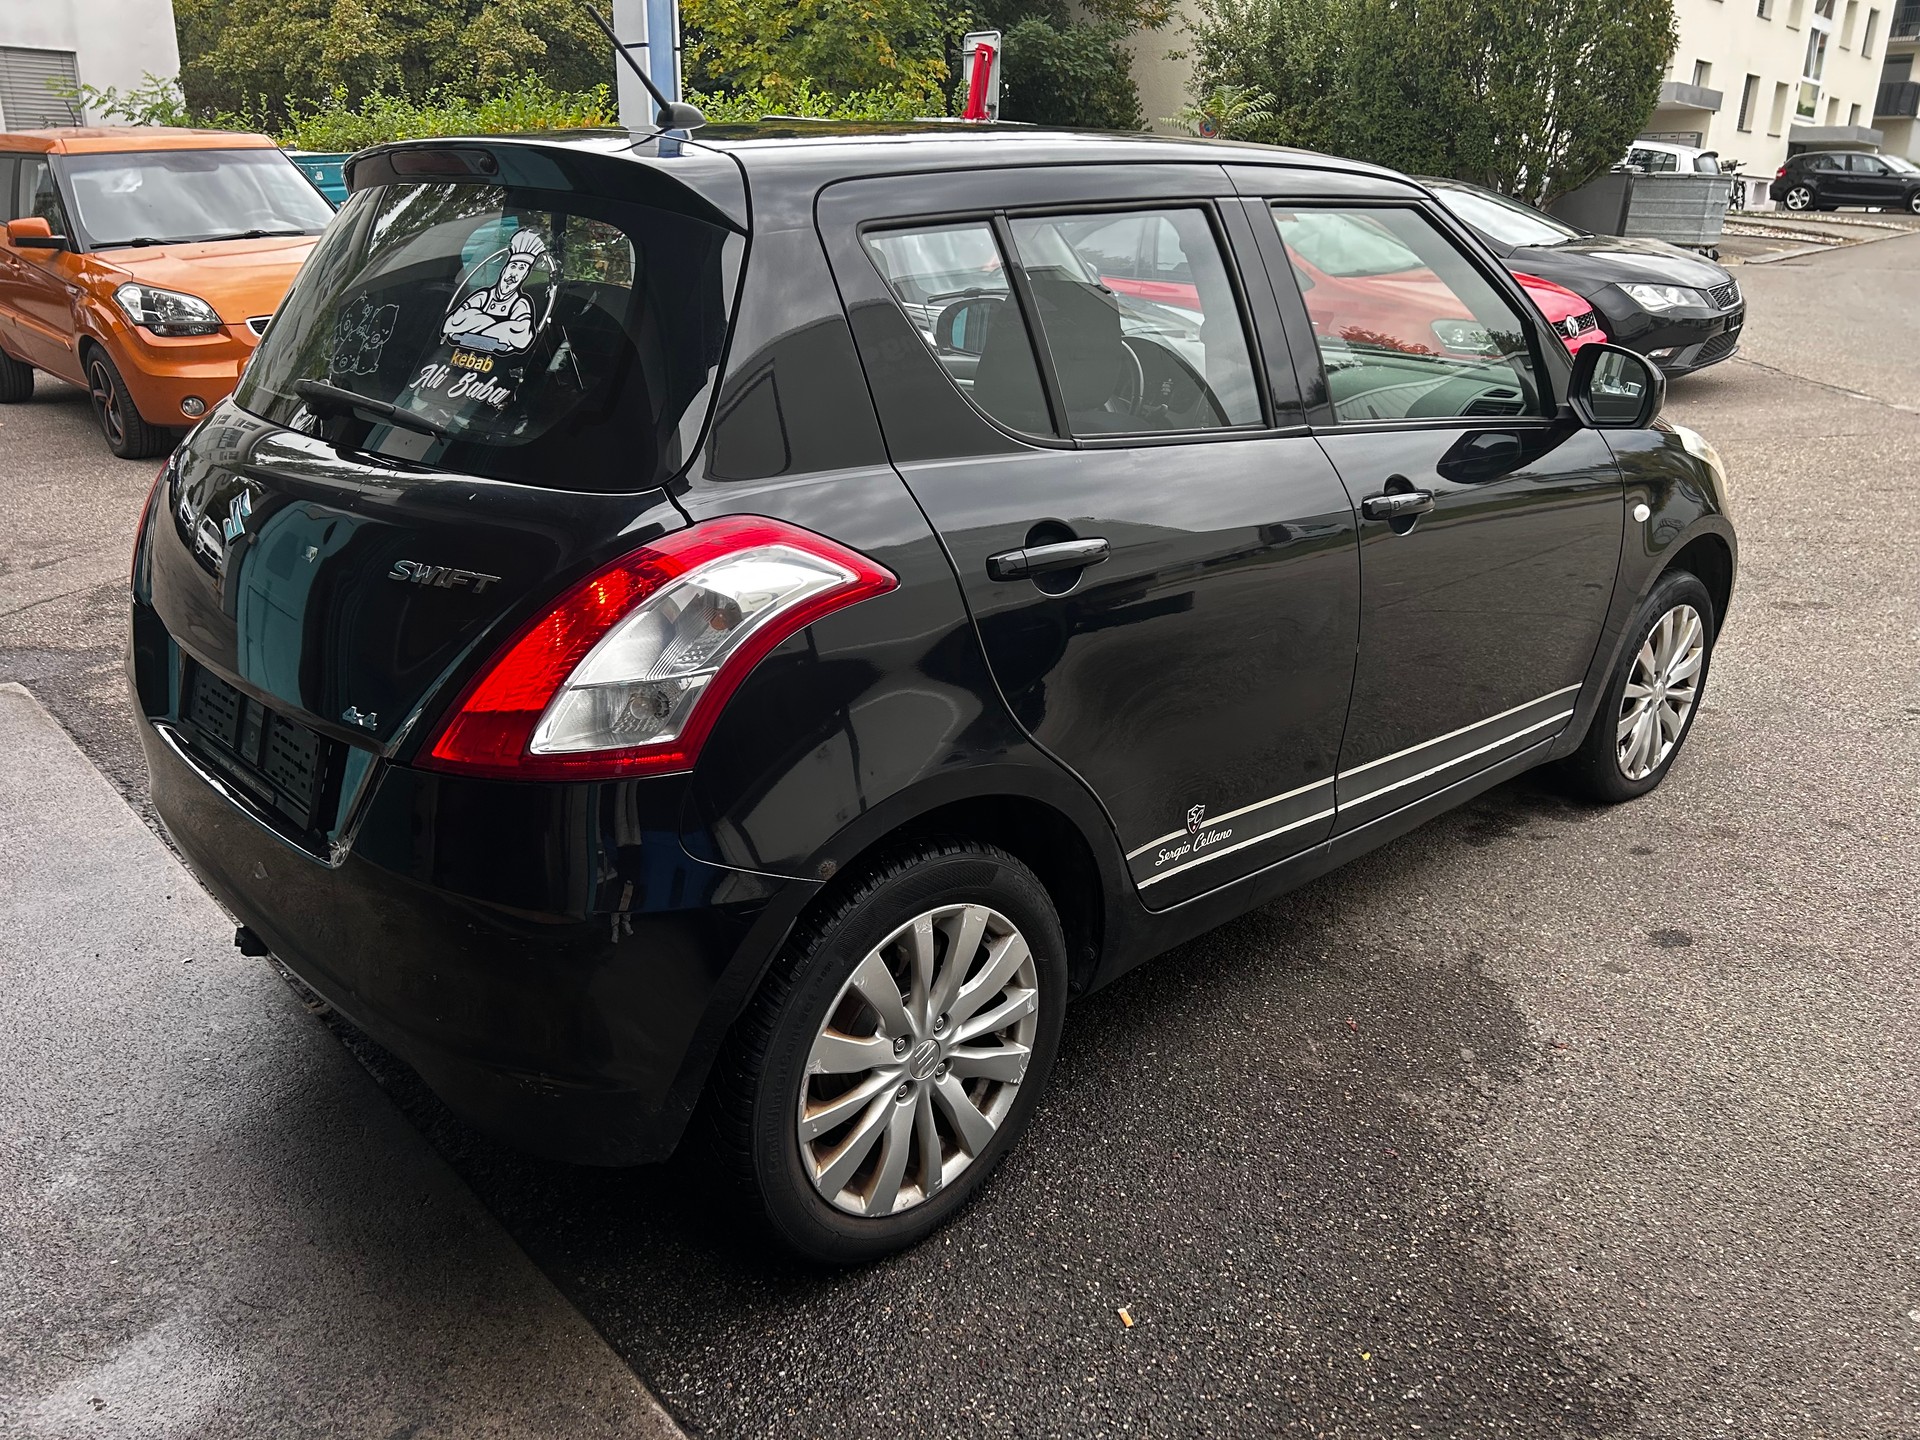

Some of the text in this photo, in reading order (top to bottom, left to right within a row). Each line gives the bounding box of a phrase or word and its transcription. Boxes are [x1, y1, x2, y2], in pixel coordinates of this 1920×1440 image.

[450, 349, 494, 374] kebab
[409, 363, 511, 404] Ali Baba
[388, 560, 502, 594] SWIFT
[1154, 828, 1233, 867] Sergio Cellano
